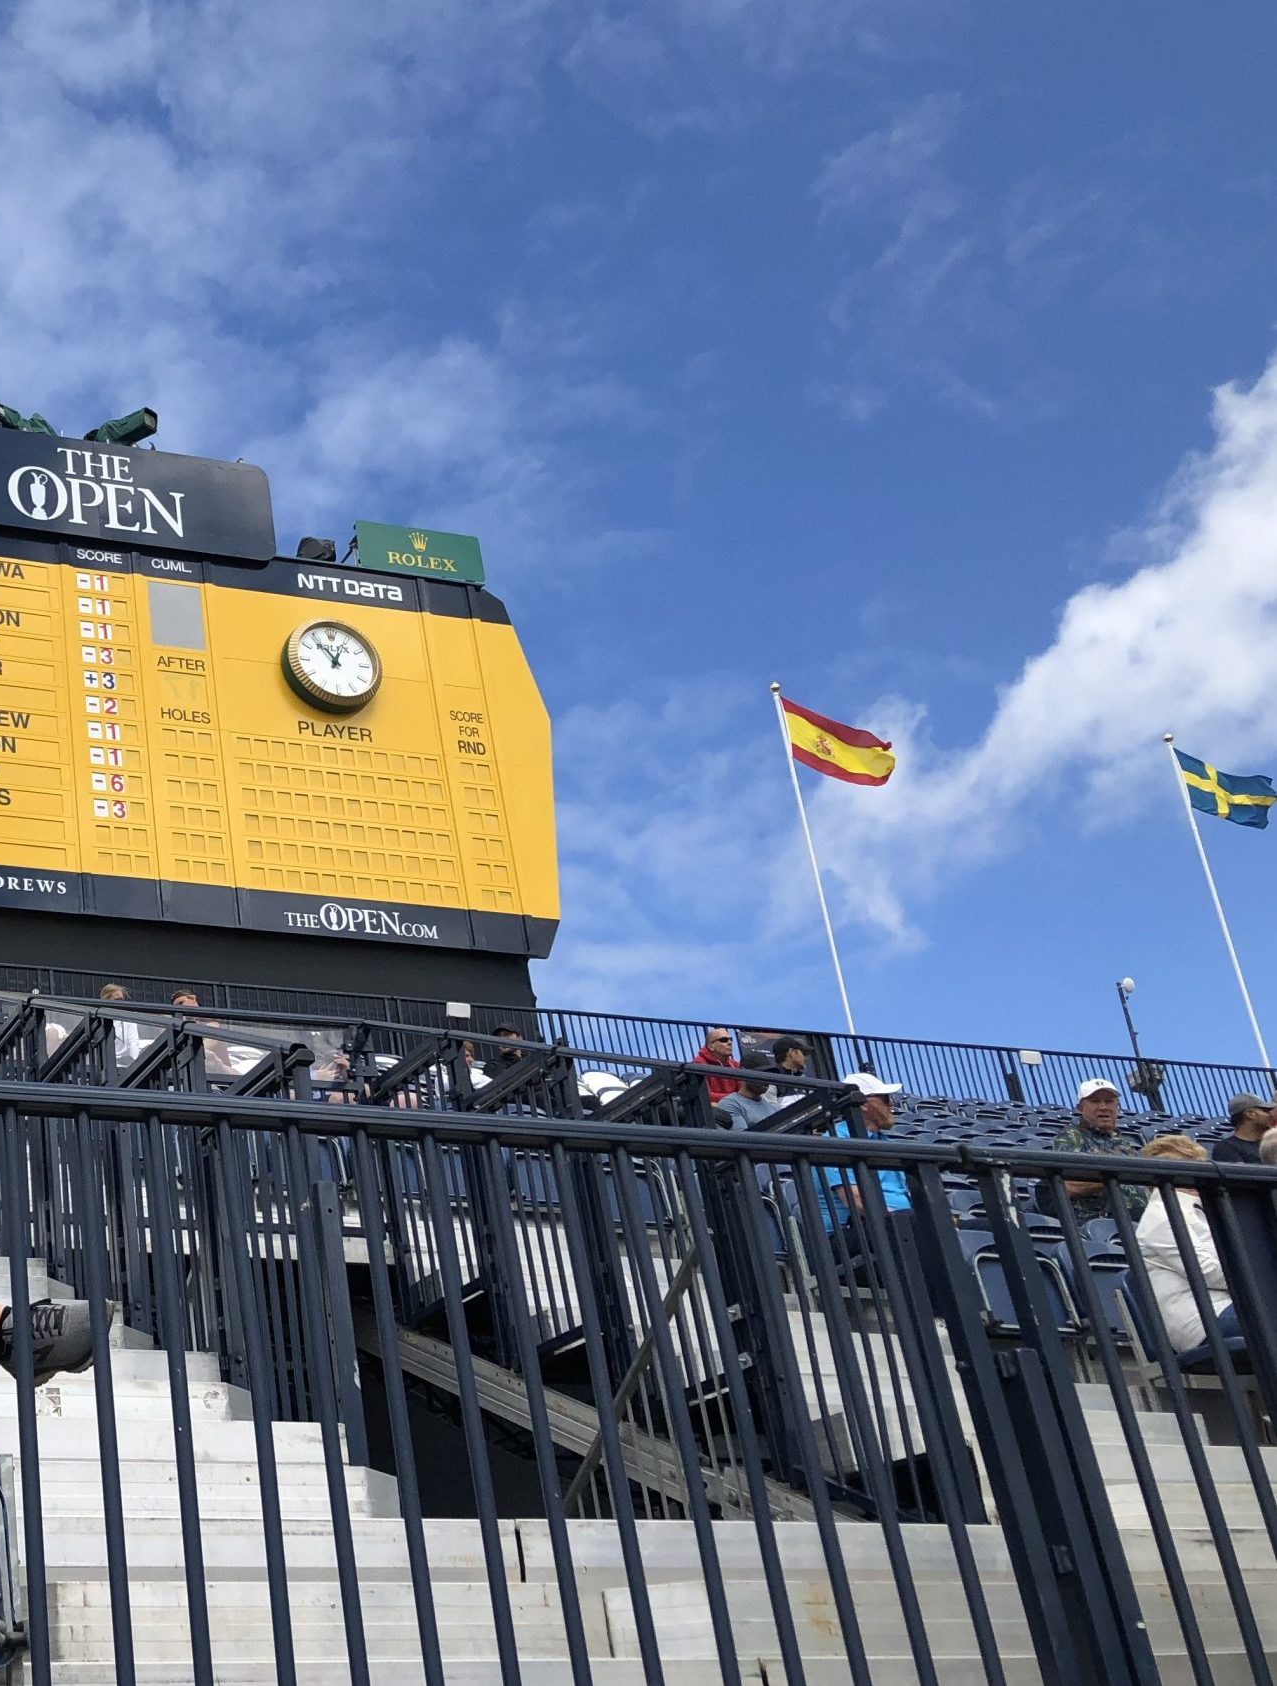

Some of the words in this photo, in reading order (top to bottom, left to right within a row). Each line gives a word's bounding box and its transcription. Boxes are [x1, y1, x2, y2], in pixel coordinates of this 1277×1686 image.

[57, 447, 134, 483] THE
[7, 465, 185, 538] OPEN
[76, 548, 123, 564] SCORE
[387, 551, 457, 573] ROLEX
[297, 573, 341, 593] NTT
[157, 655, 206, 672] AFTER
[160, 707, 212, 725] HOLES
[449, 710, 484, 724] SCORE
[297, 720, 373, 743] PLAYER
[458, 726, 479, 738] FOR
[457, 740, 487, 756] RND
